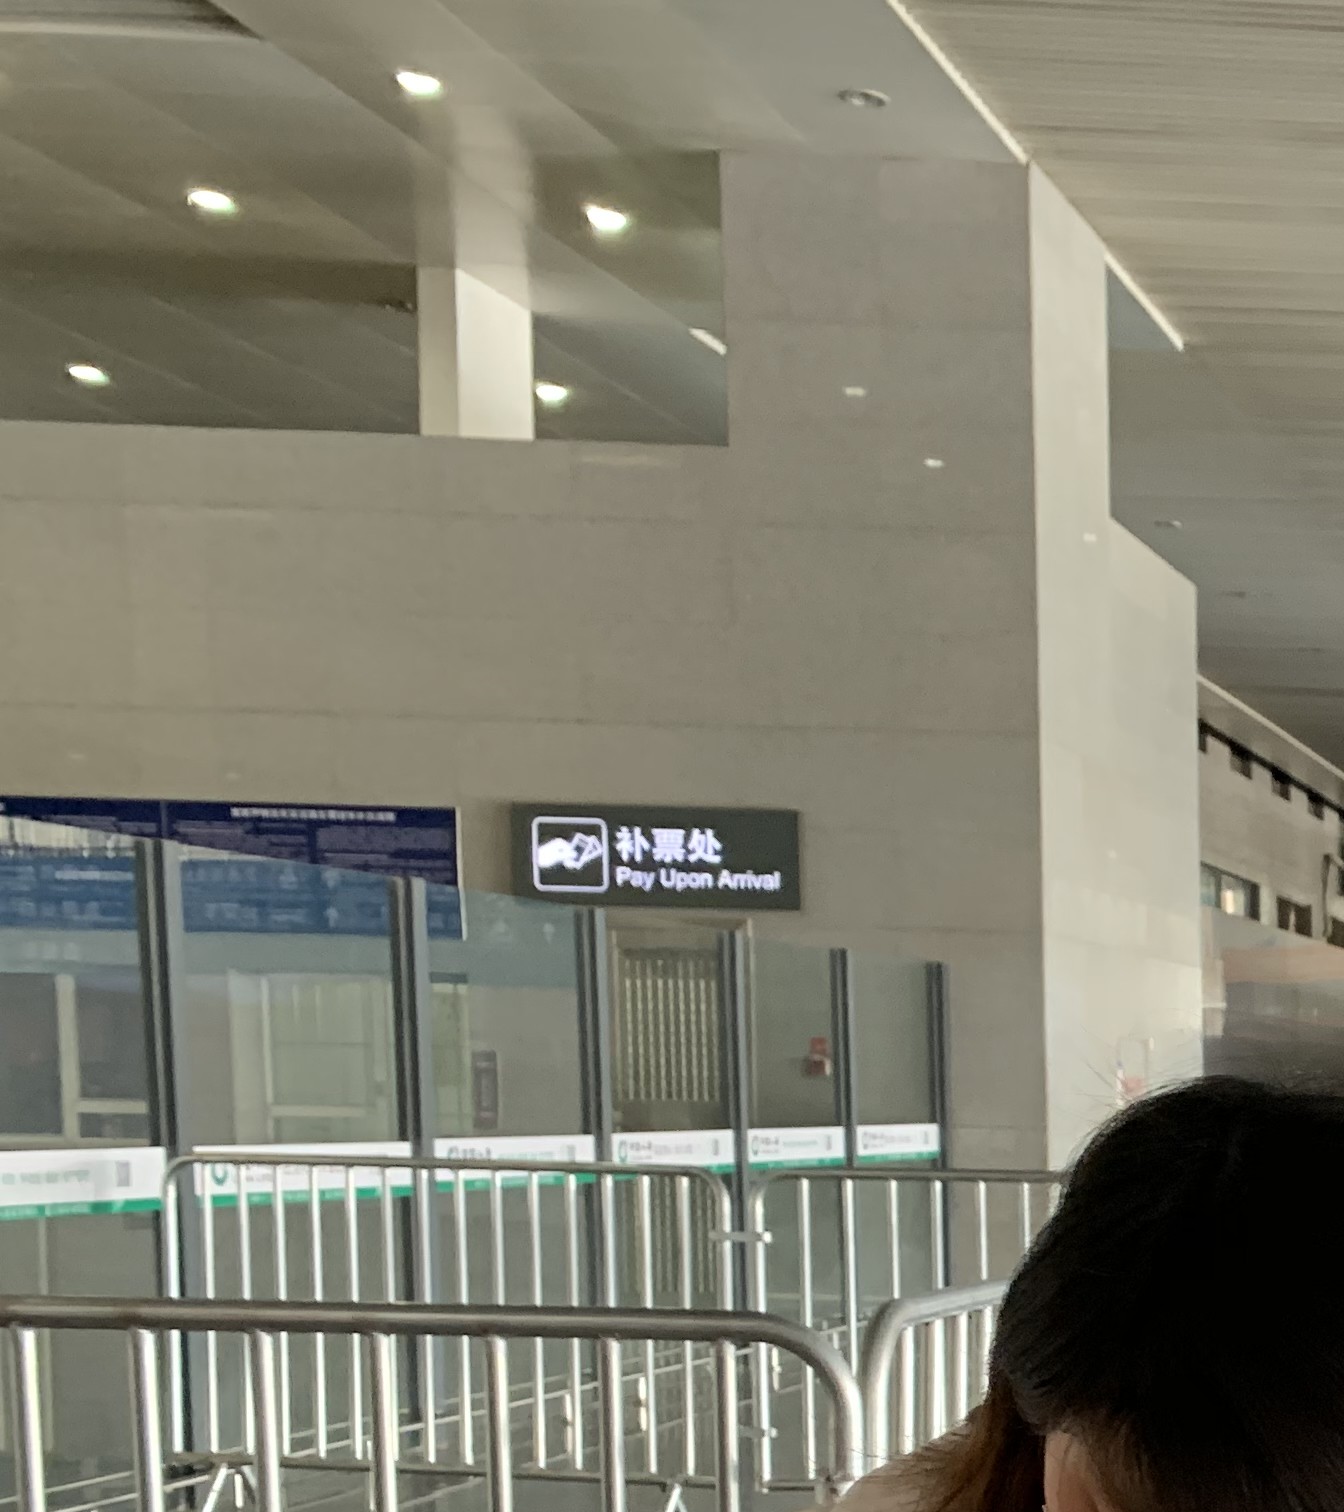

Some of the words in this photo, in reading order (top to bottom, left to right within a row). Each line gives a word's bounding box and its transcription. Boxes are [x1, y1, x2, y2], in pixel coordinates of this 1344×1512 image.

[614, 825, 722, 864] 补票处
[615, 866, 656, 891] Pay
[659, 868, 713, 893] Upon
[717, 870, 782, 891] Arrival
